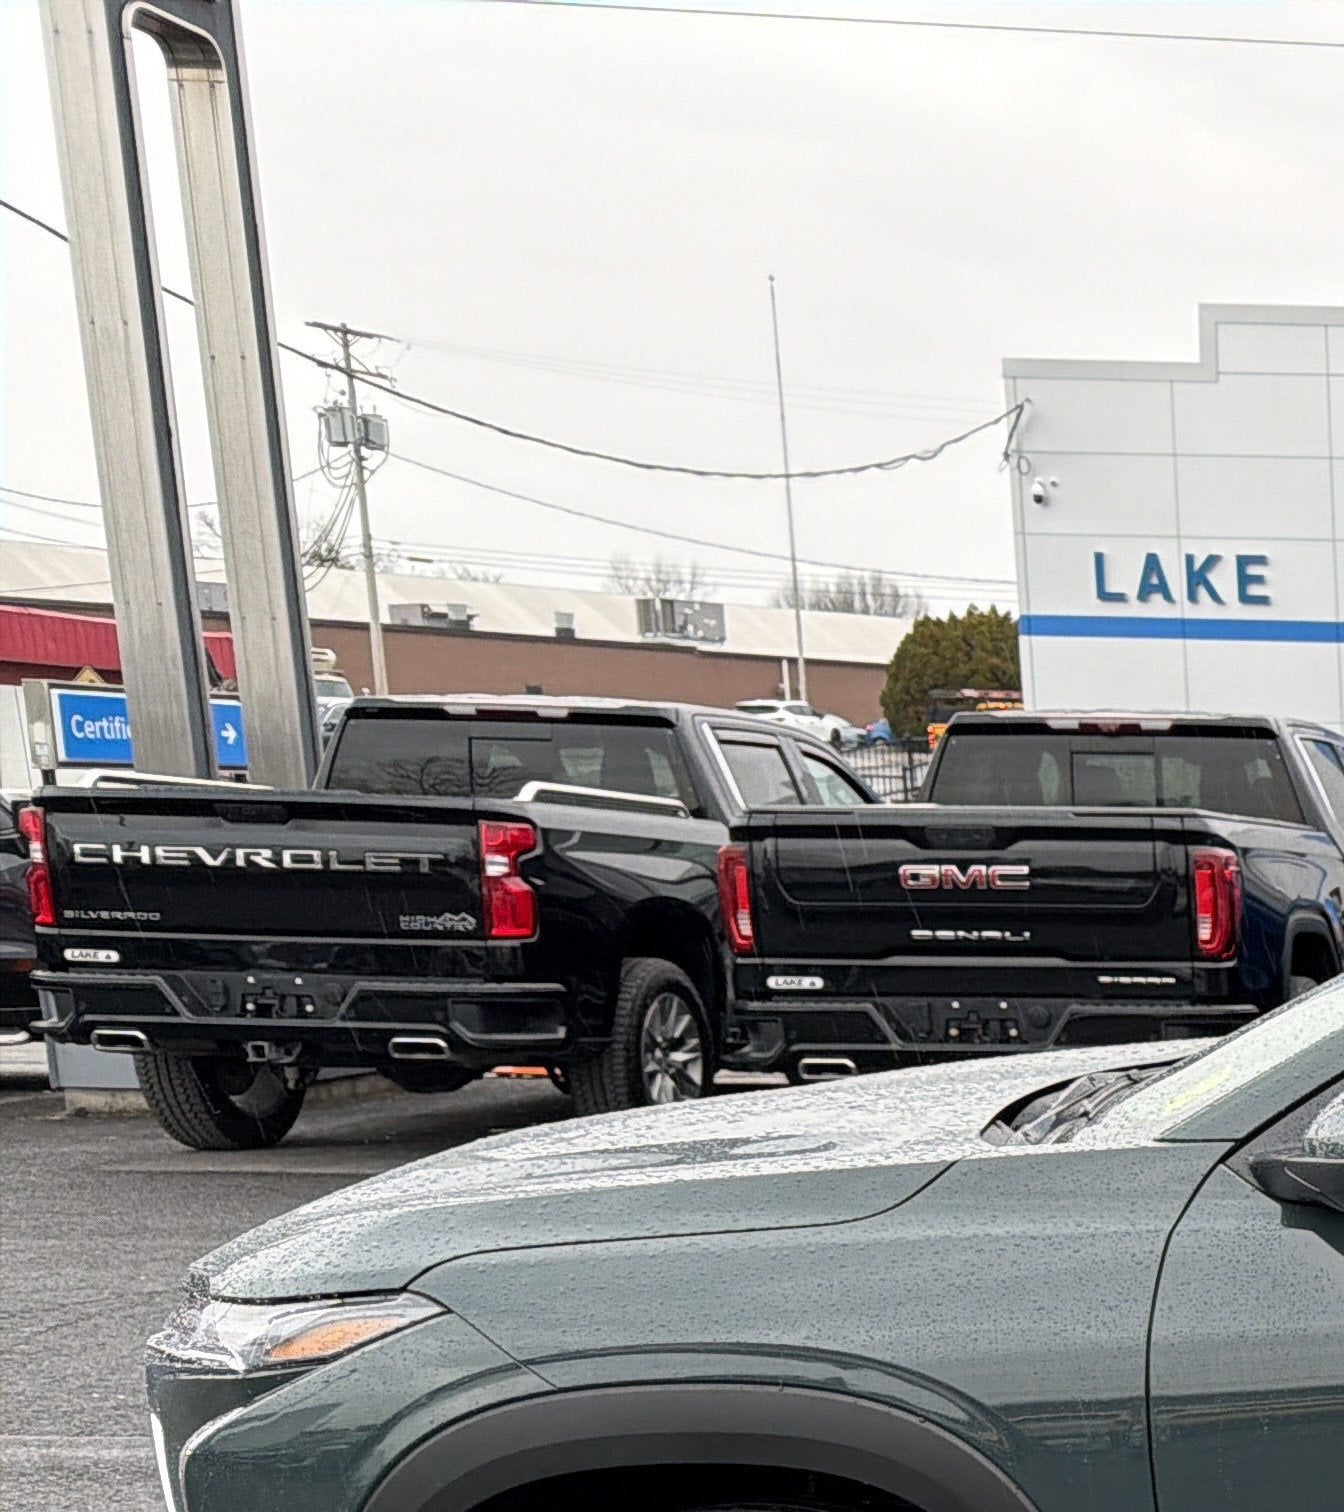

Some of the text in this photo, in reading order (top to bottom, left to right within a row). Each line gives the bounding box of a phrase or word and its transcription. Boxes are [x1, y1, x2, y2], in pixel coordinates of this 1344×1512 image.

[1093, 551, 1274, 605] LAKE
[72, 843, 445, 873] CHEVROLET
[898, 864, 1031, 890] GMC
[62, 909, 161, 921] SILVERADO
[910, 929, 1031, 941] DENALI
[70, 949, 100, 960] LAKE
